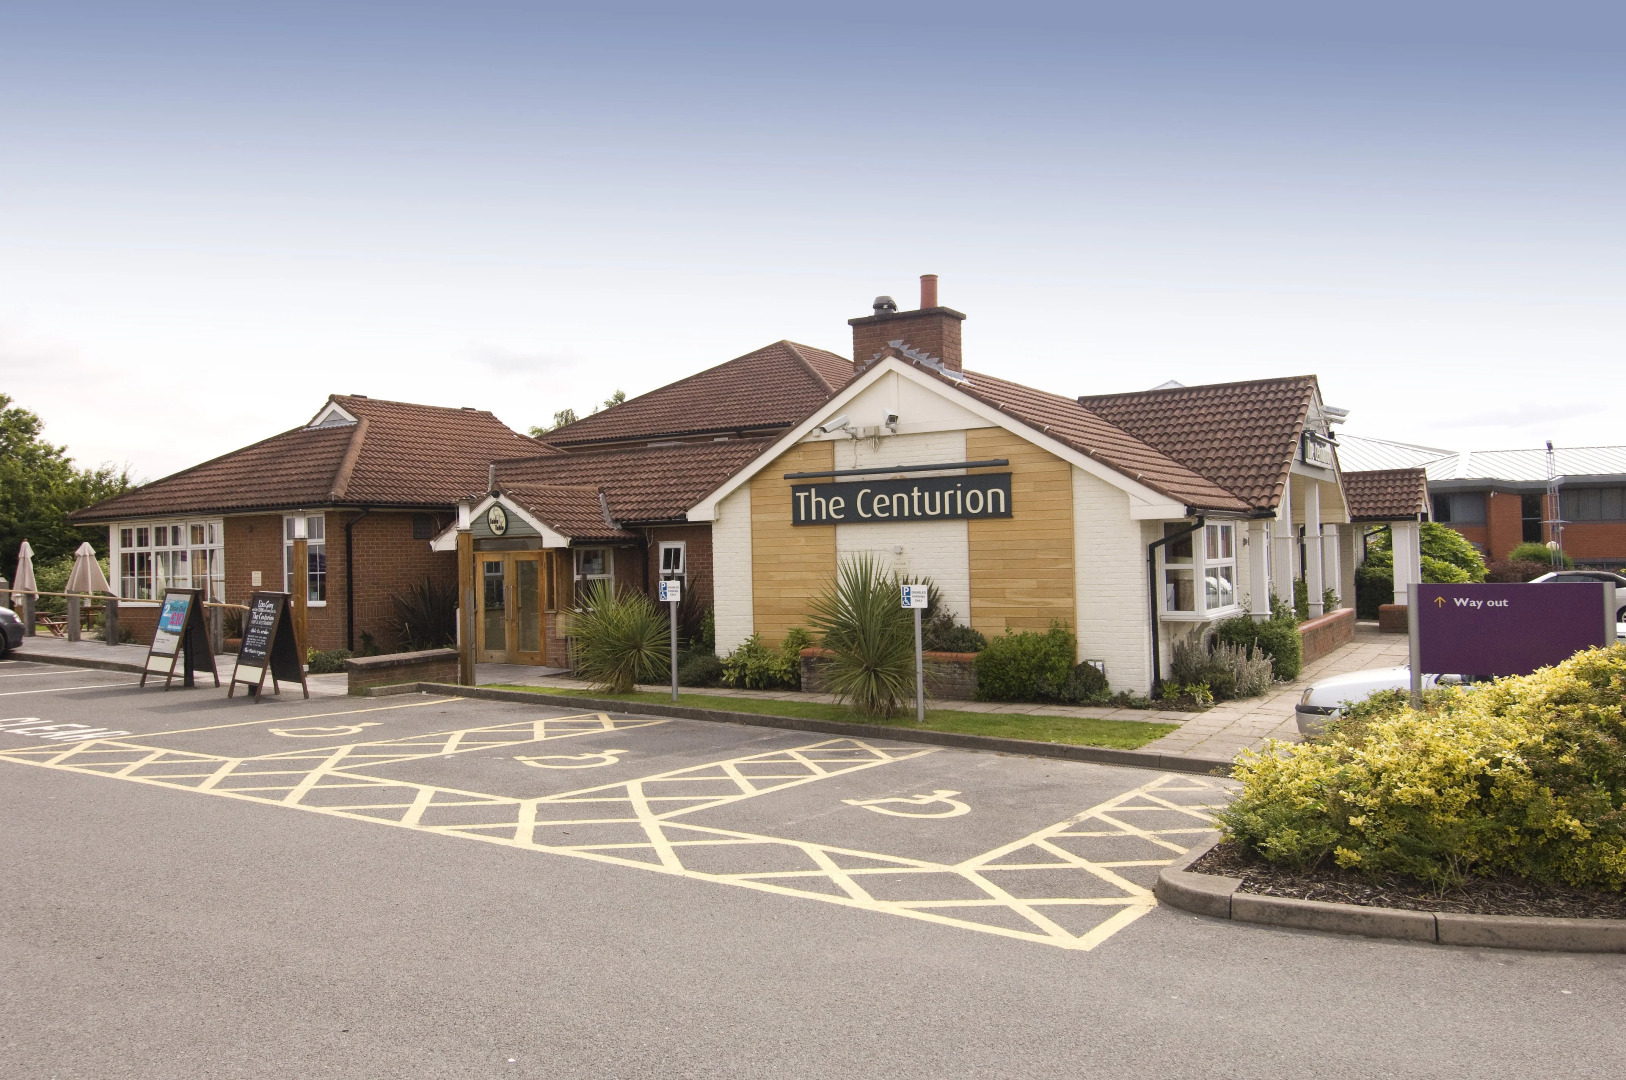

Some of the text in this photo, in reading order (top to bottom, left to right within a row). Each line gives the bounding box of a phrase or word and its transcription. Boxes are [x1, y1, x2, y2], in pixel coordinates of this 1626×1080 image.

[795, 483, 1006, 520] The Centurion
[904, 587, 909, 595] P
[1453, 597, 1508, 609] Way out
[163, 604, 170, 617] 2
[169, 612, 184, 625] £10
